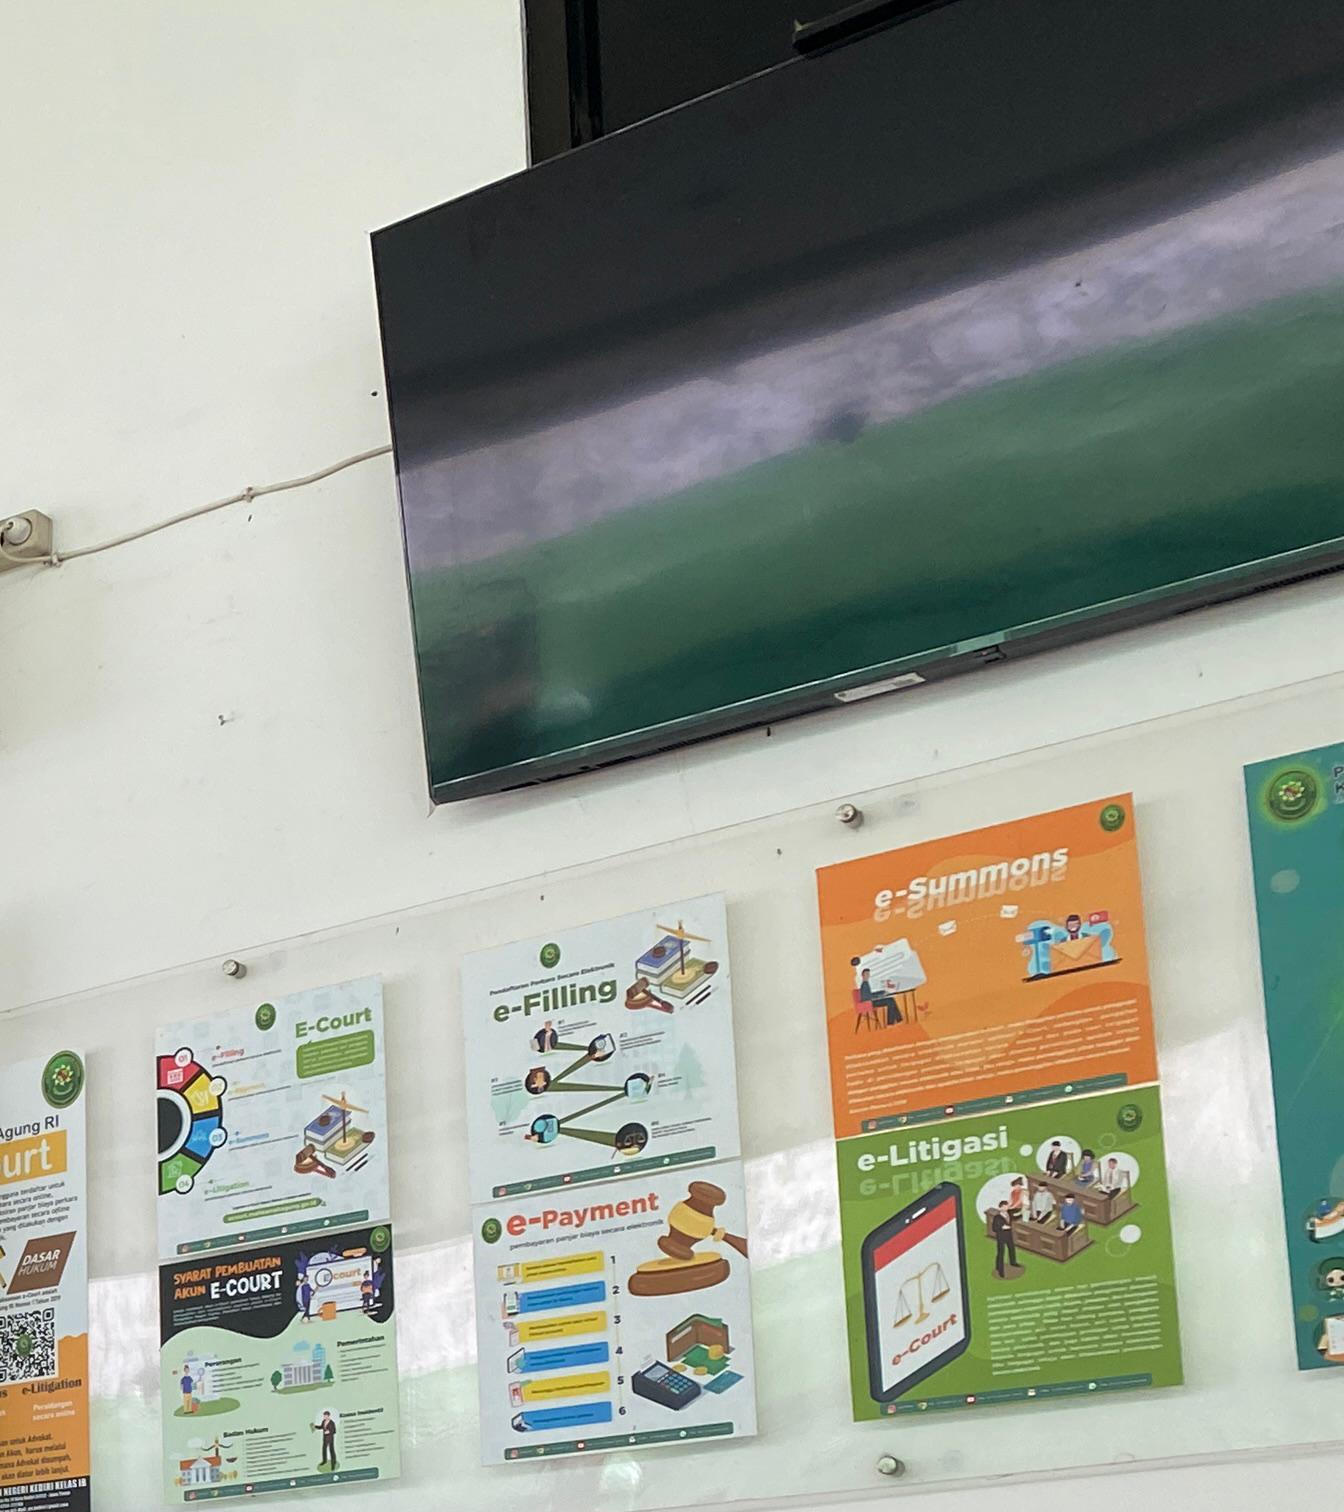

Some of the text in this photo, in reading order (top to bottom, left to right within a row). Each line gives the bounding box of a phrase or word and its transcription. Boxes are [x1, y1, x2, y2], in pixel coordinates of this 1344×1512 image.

[875, 848, 1069, 907] e-Summons
[493, 979, 618, 1022] e-Filling
[295, 1007, 373, 1038] E-Court
[45, 1115, 60, 1129] RI
[857, 1125, 1009, 1172] e-Litigasi
[506, 1192, 660, 1236] e-Payment
[22, 1249, 61, 1266] DASAR
[610, 1255, 616, 1264] 1
[18, 1261, 58, 1276] HUKUM
[173, 1257, 282, 1285] SYARAT PEMBUATAN
[174, 1271, 283, 1300] AKUN E-COURT
[612, 1285, 620, 1295] 2
[614, 1315, 621, 1324] 3
[891, 1313, 958, 1366] e-Court
[615, 1346, 623, 1355] 4
[22, 1378, 82, 1396] e-Litigation
[617, 1376, 624, 1385] 5
[619, 1406, 626, 1415] 6
[3, 1485, 29, 1497] NEGERI
[29, 1481, 54, 1493] KEDIRI
[54, 1478, 78, 1490] KELAS
